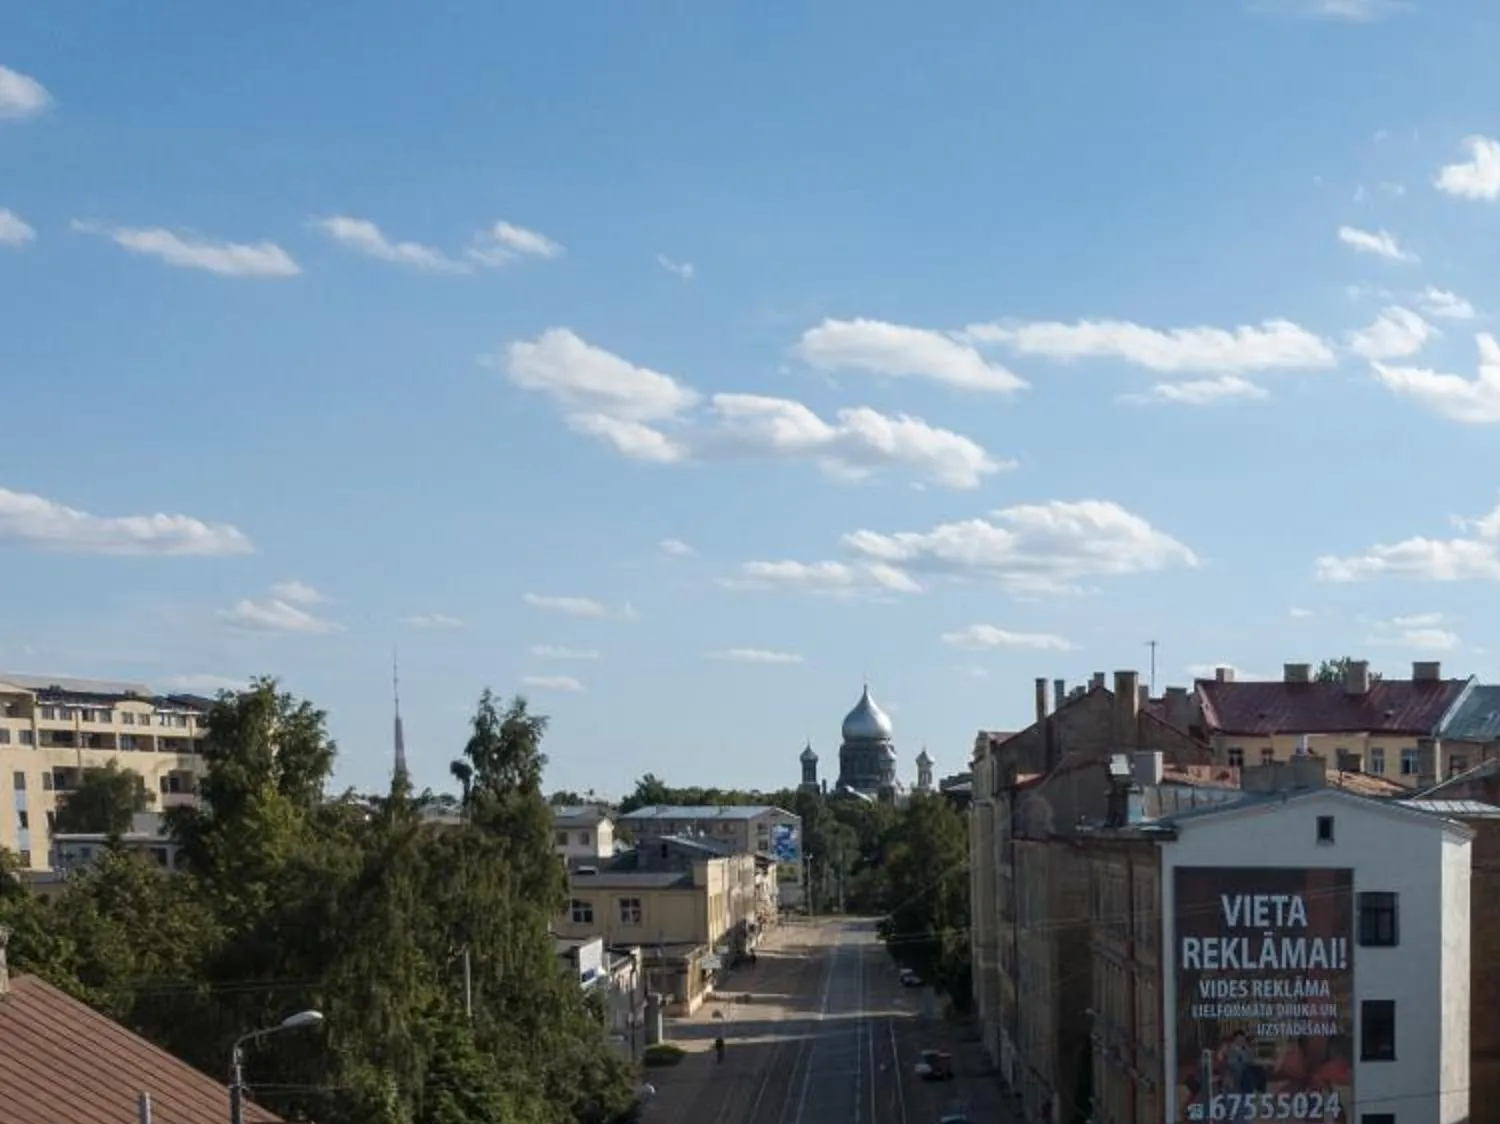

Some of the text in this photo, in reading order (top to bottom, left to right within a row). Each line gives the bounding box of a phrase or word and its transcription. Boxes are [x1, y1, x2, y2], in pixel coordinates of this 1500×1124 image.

[1220, 894, 1308, 927] VIETA
[1182, 931, 1347, 970] REKLĀMAI!
[1199, 975, 1330, 998] VIDES REKLĀMA
[1212, 1091, 1342, 1120] 67555024
